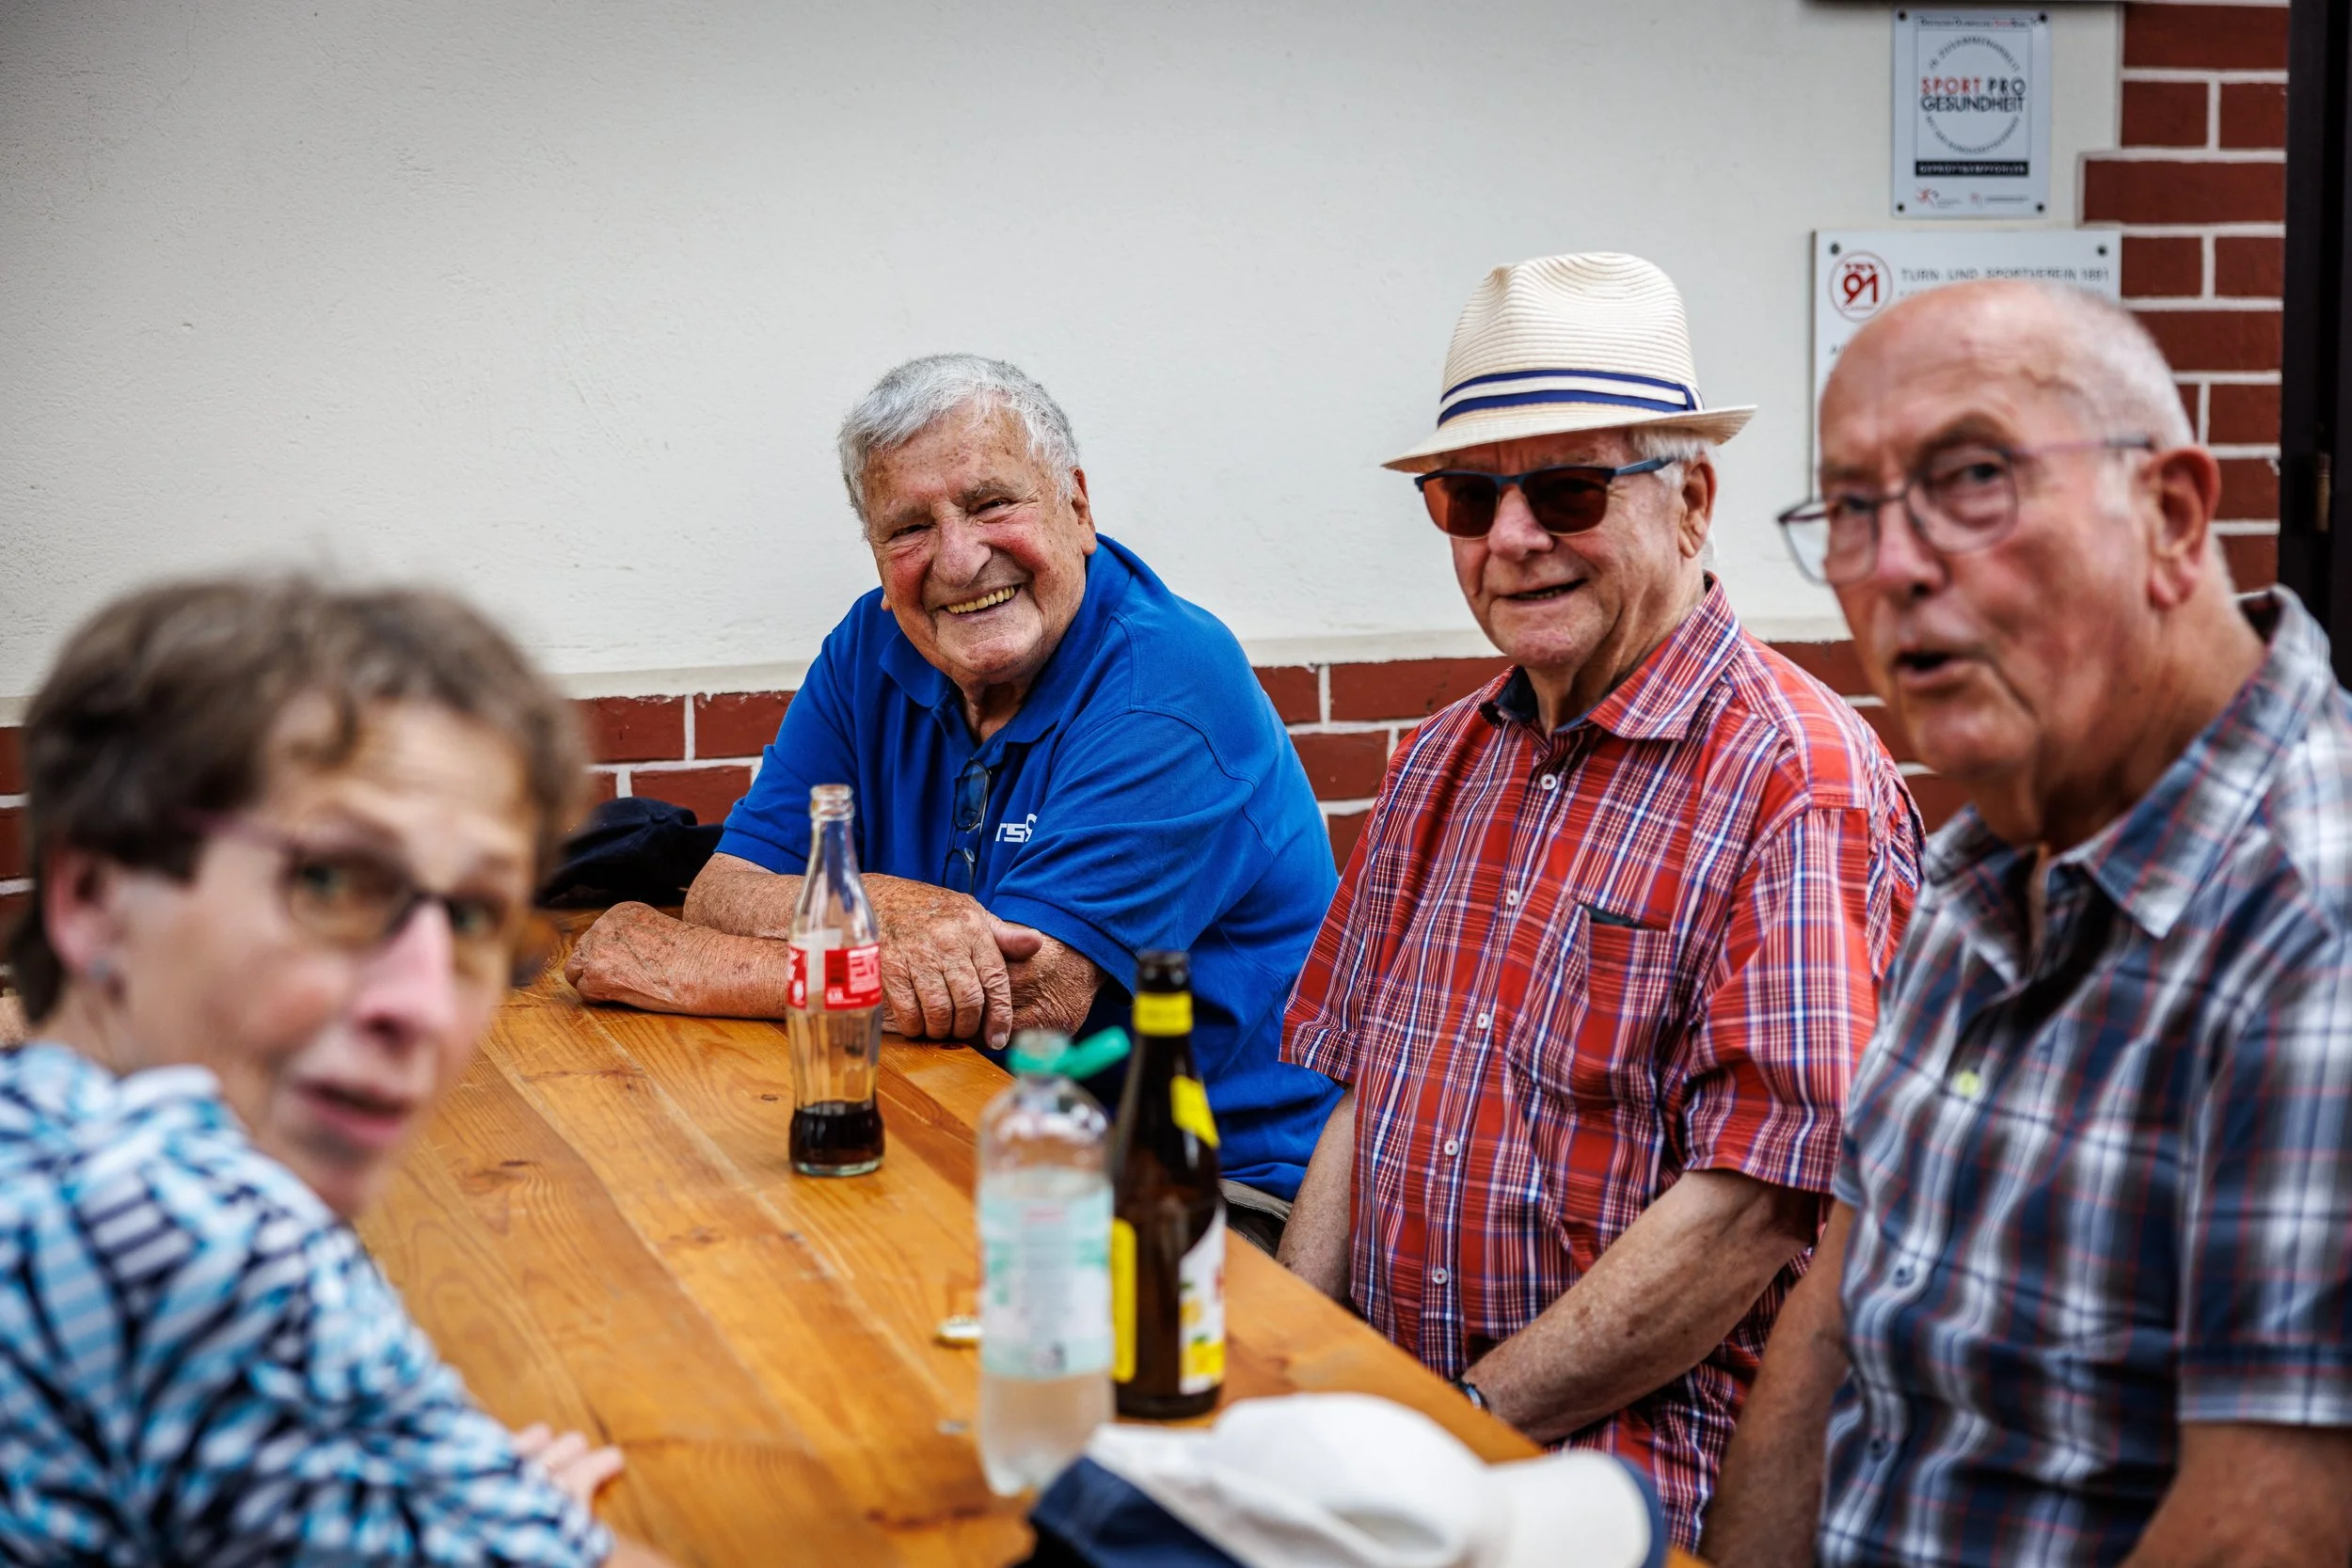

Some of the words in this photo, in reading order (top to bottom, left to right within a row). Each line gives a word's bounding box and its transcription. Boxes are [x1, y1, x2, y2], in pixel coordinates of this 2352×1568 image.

[1921, 76, 1980, 95] SPORT
[1988, 76, 2026, 96] PRO
[1920, 95, 2026, 112] GESUNDHEIT
[1946, 267, 1979, 280] UND
[1843, 273, 1878, 305] 91
